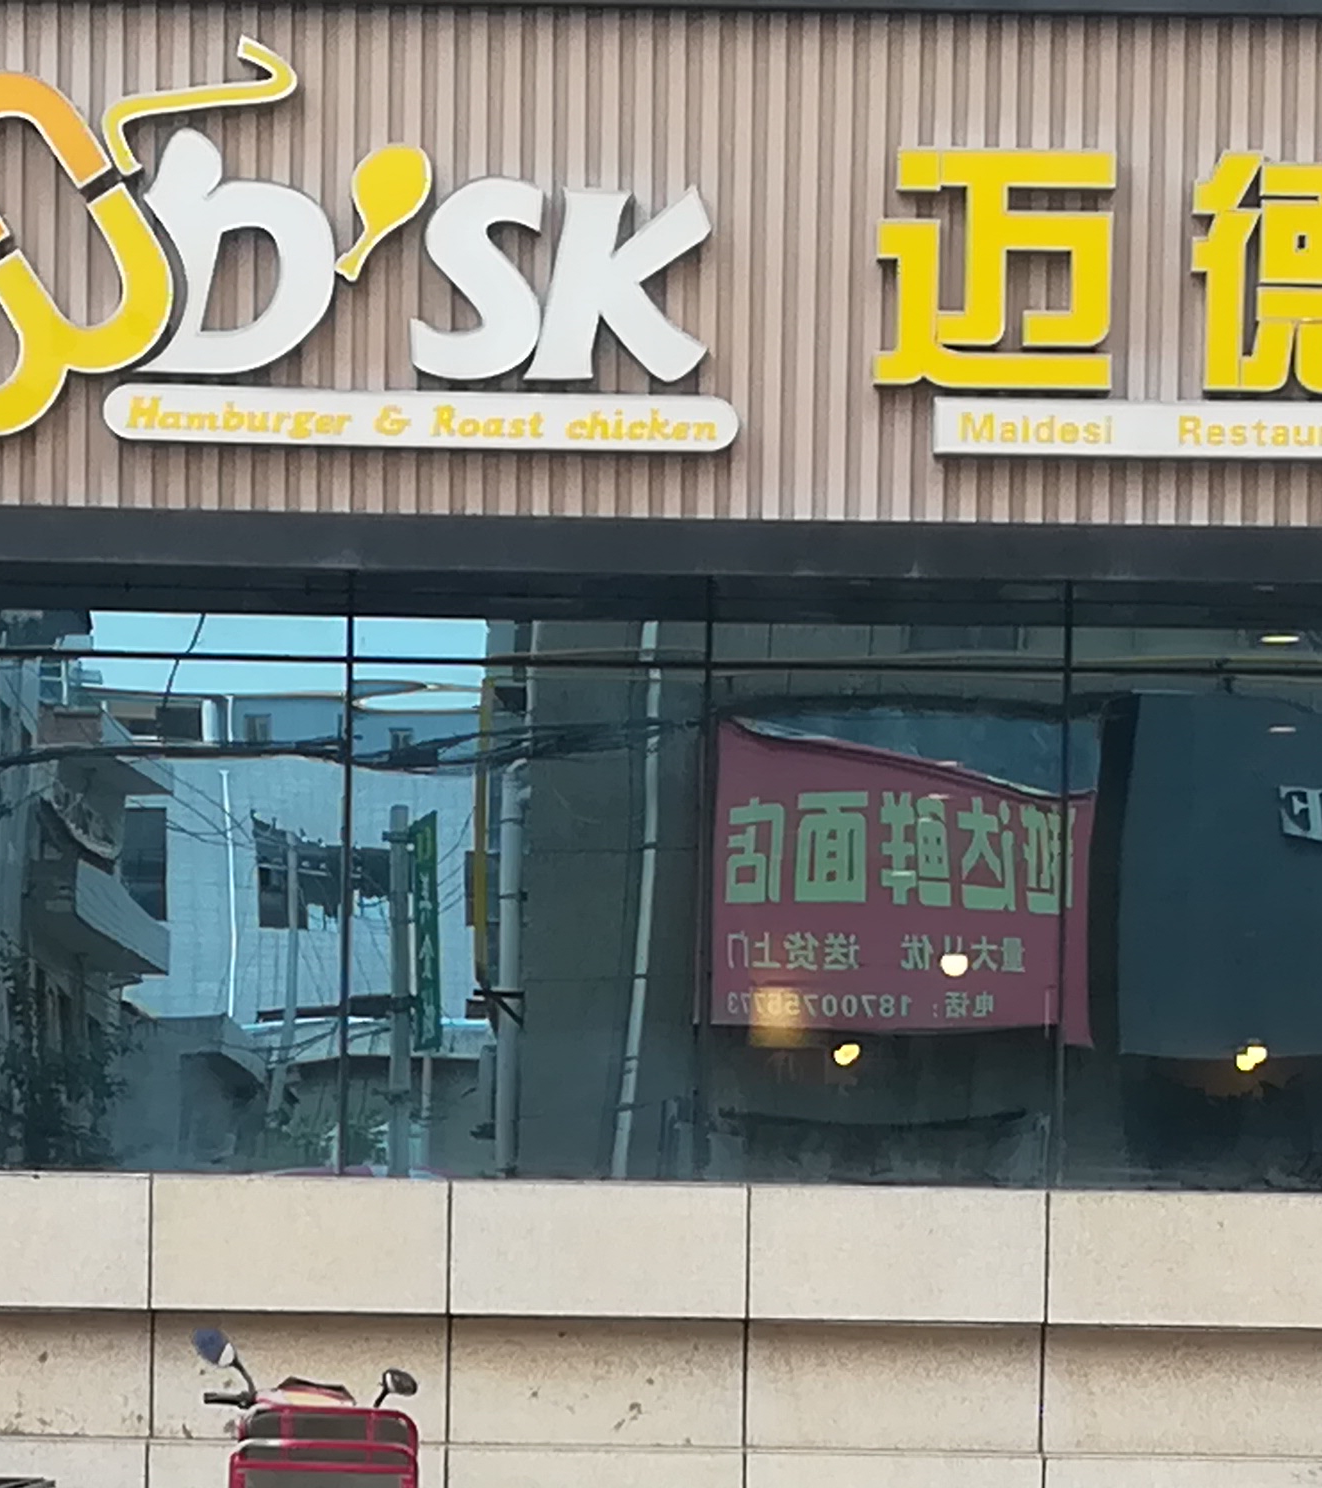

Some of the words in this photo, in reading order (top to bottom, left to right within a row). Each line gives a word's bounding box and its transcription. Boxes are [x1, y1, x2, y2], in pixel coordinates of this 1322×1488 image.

[126, 395, 351, 439] Hamburger
[375, 404, 410, 437] &
[431, 405, 544, 439] Roast
[565, 404, 717, 442] chicken
[958, 411, 1113, 444] Maidesi
